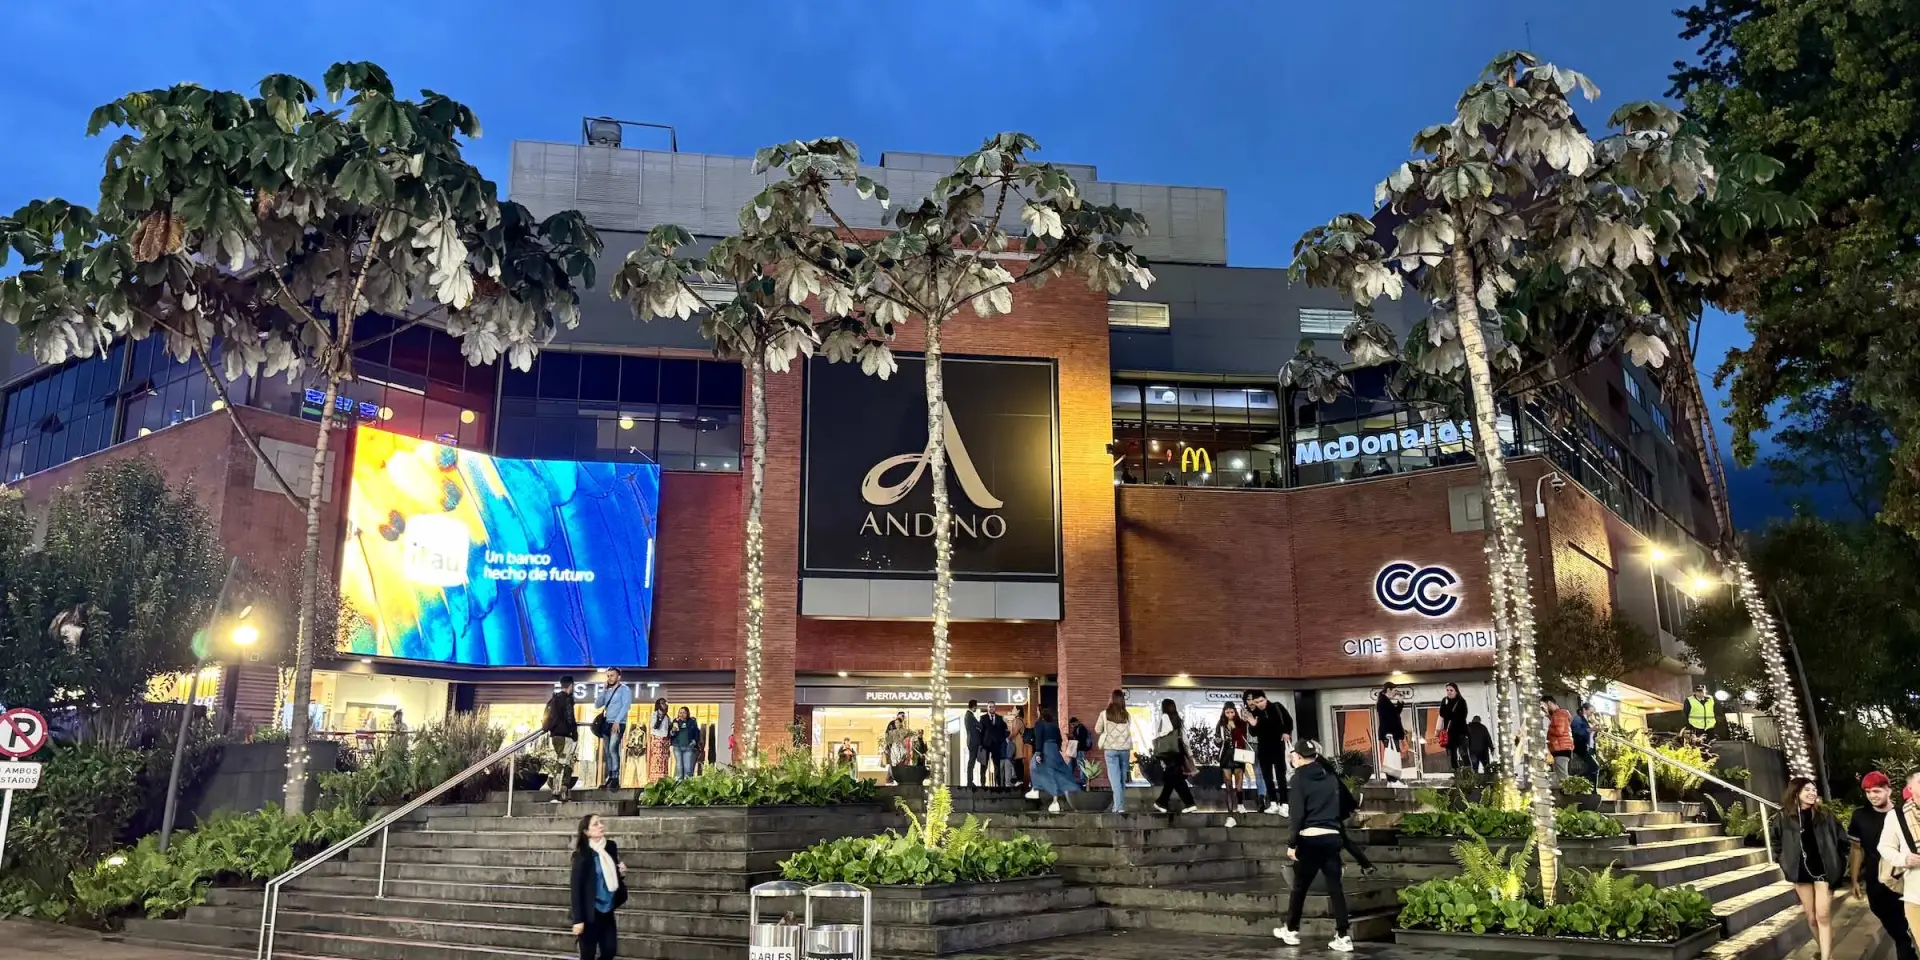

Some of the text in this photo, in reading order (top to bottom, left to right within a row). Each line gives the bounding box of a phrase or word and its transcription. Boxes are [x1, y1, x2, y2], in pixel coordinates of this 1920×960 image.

[859, 511, 1007, 539] ANDNO
[484, 550, 551, 566] Un banco
[483, 564, 595, 582] hecho de futuro
[1343, 631, 1497, 656] CINE COLOMBI
[866, 691, 897, 700] PUERTA
[898, 691, 924, 700] PLAZA
[5, 767, 38, 775] AMBOS
